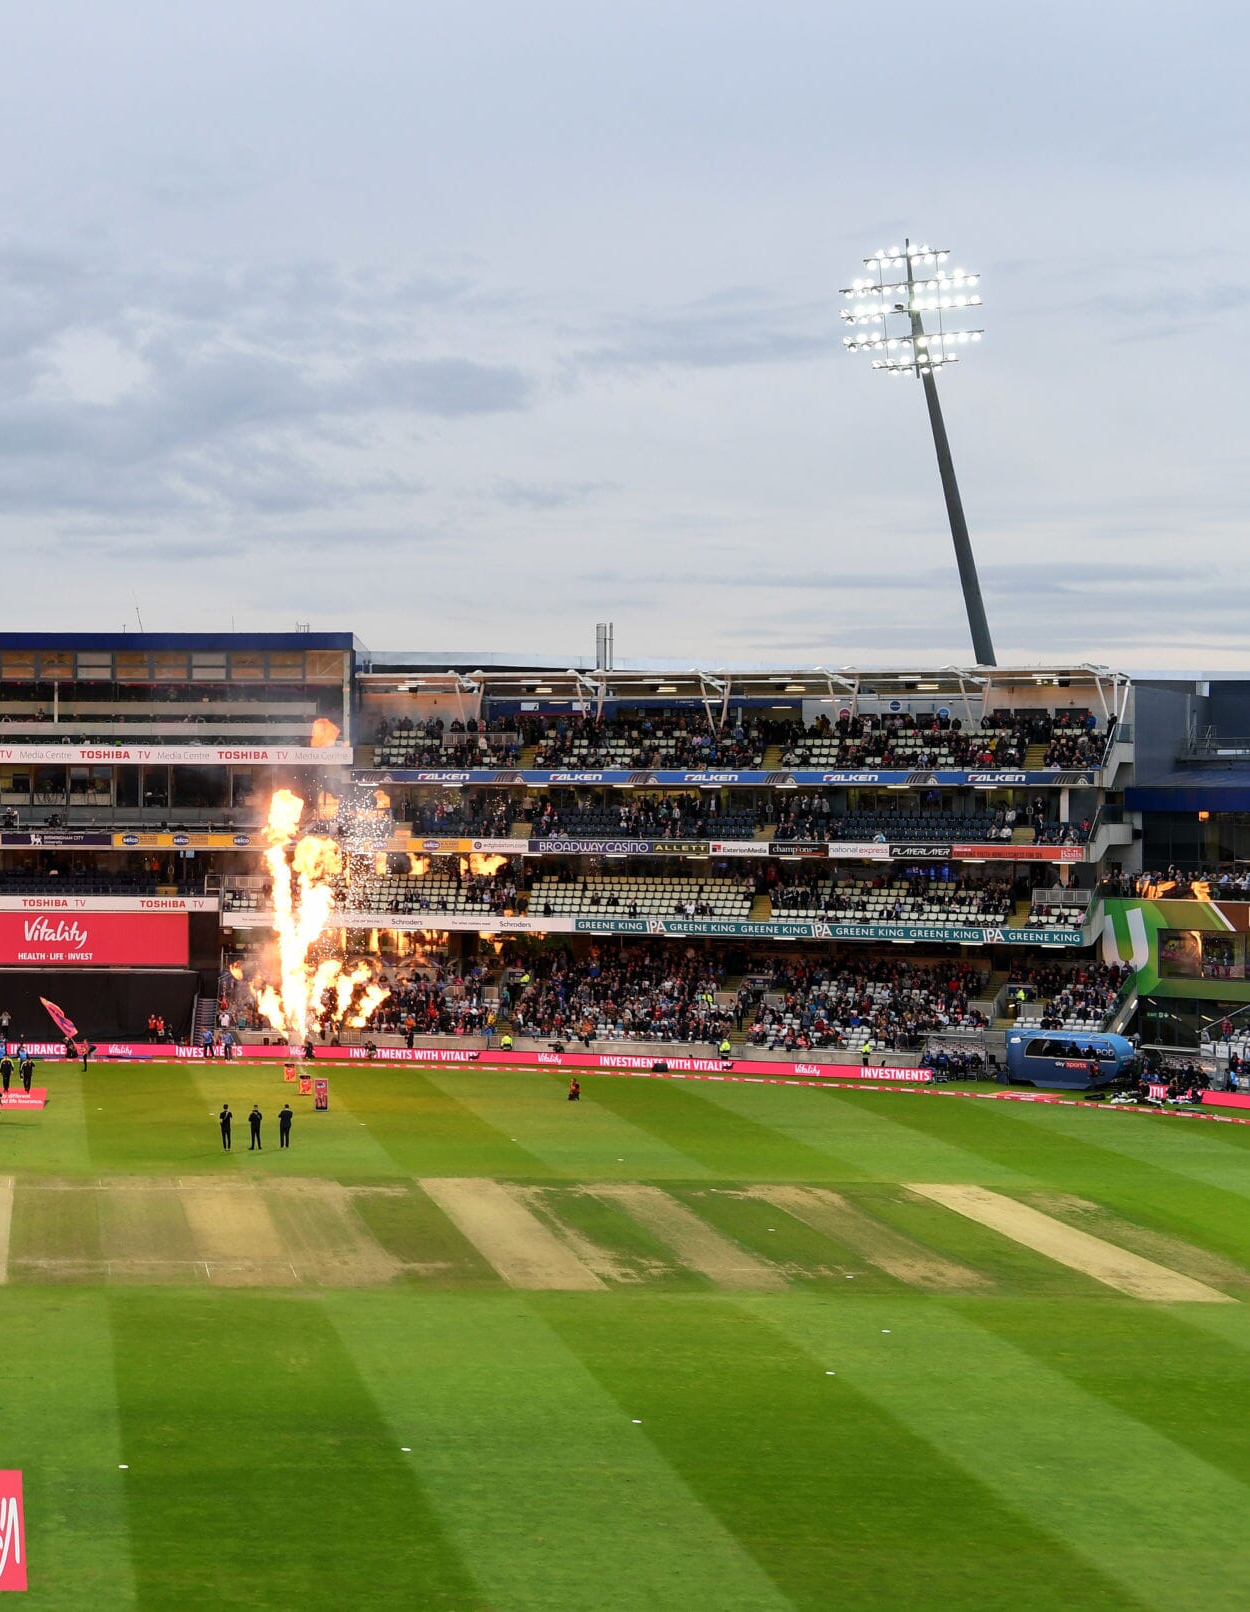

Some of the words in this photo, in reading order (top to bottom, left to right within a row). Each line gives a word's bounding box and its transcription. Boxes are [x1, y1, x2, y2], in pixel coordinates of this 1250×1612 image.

[0, 750, 12, 758] TV
[20, 751, 44, 759] Media
[45, 751, 71, 759] Centre
[80, 750, 130, 759] TOSHIBA
[138, 751, 151, 759] TV
[158, 751, 182, 760] Media
[183, 752, 209, 760] Centre
[218, 751, 268, 760] TOSHIBA
[276, 752, 288, 760] TV
[550, 773, 602, 781] FALKEN
[823, 774, 878, 782] FALKEN
[968, 774, 1026, 782] FALKEN
[539, 841, 606, 852] BROADWAY
[892, 847, 950, 856] PLAYERLAYER
[22, 899, 68, 907] TOSHIBA
[74, 899, 86, 907] TV
[140, 900, 186, 908] TOSHIBA
[193, 900, 205, 908] TV
[391, 918, 423, 926] Schroders
[499, 920, 532, 928] Schroders
[578, 921, 615, 929] GREENE
[618, 922, 643, 930] KING
[646, 920, 667, 933] IPA
[24, 915, 88, 950] Vitality
[669, 923, 707, 931] GREENE
[711, 924, 736, 932] KING
[740, 925, 779, 933] GREENE
[782, 925, 808, 934] KING
[811, 924, 833, 937] IPA
[835, 927, 875, 936] GREENE
[878, 928, 904, 937] KING
[909, 929, 950, 938] GREENE
[953, 930, 979, 938] KING
[982, 929, 1005, 942] IPA
[1008, 932, 1049, 941] GREENE
[1053, 933, 1080, 942] KING
[18, 953, 46, 961] HEALTH
[49, 953, 64, 961] LIFE
[68, 953, 93, 961] INVEST
[109, 1043, 133, 1055] Vitality
[349, 1048, 412, 1059] INVTMENTS
[414, 1049, 438, 1060] WITH
[537, 1053, 562, 1065] Vitality
[666, 1058, 690, 1069] WITH
[794, 1064, 820, 1076] Vitality
[1066, 1061, 1087, 1069] sports
[861, 1067, 930, 1080] INVESTMENTS
